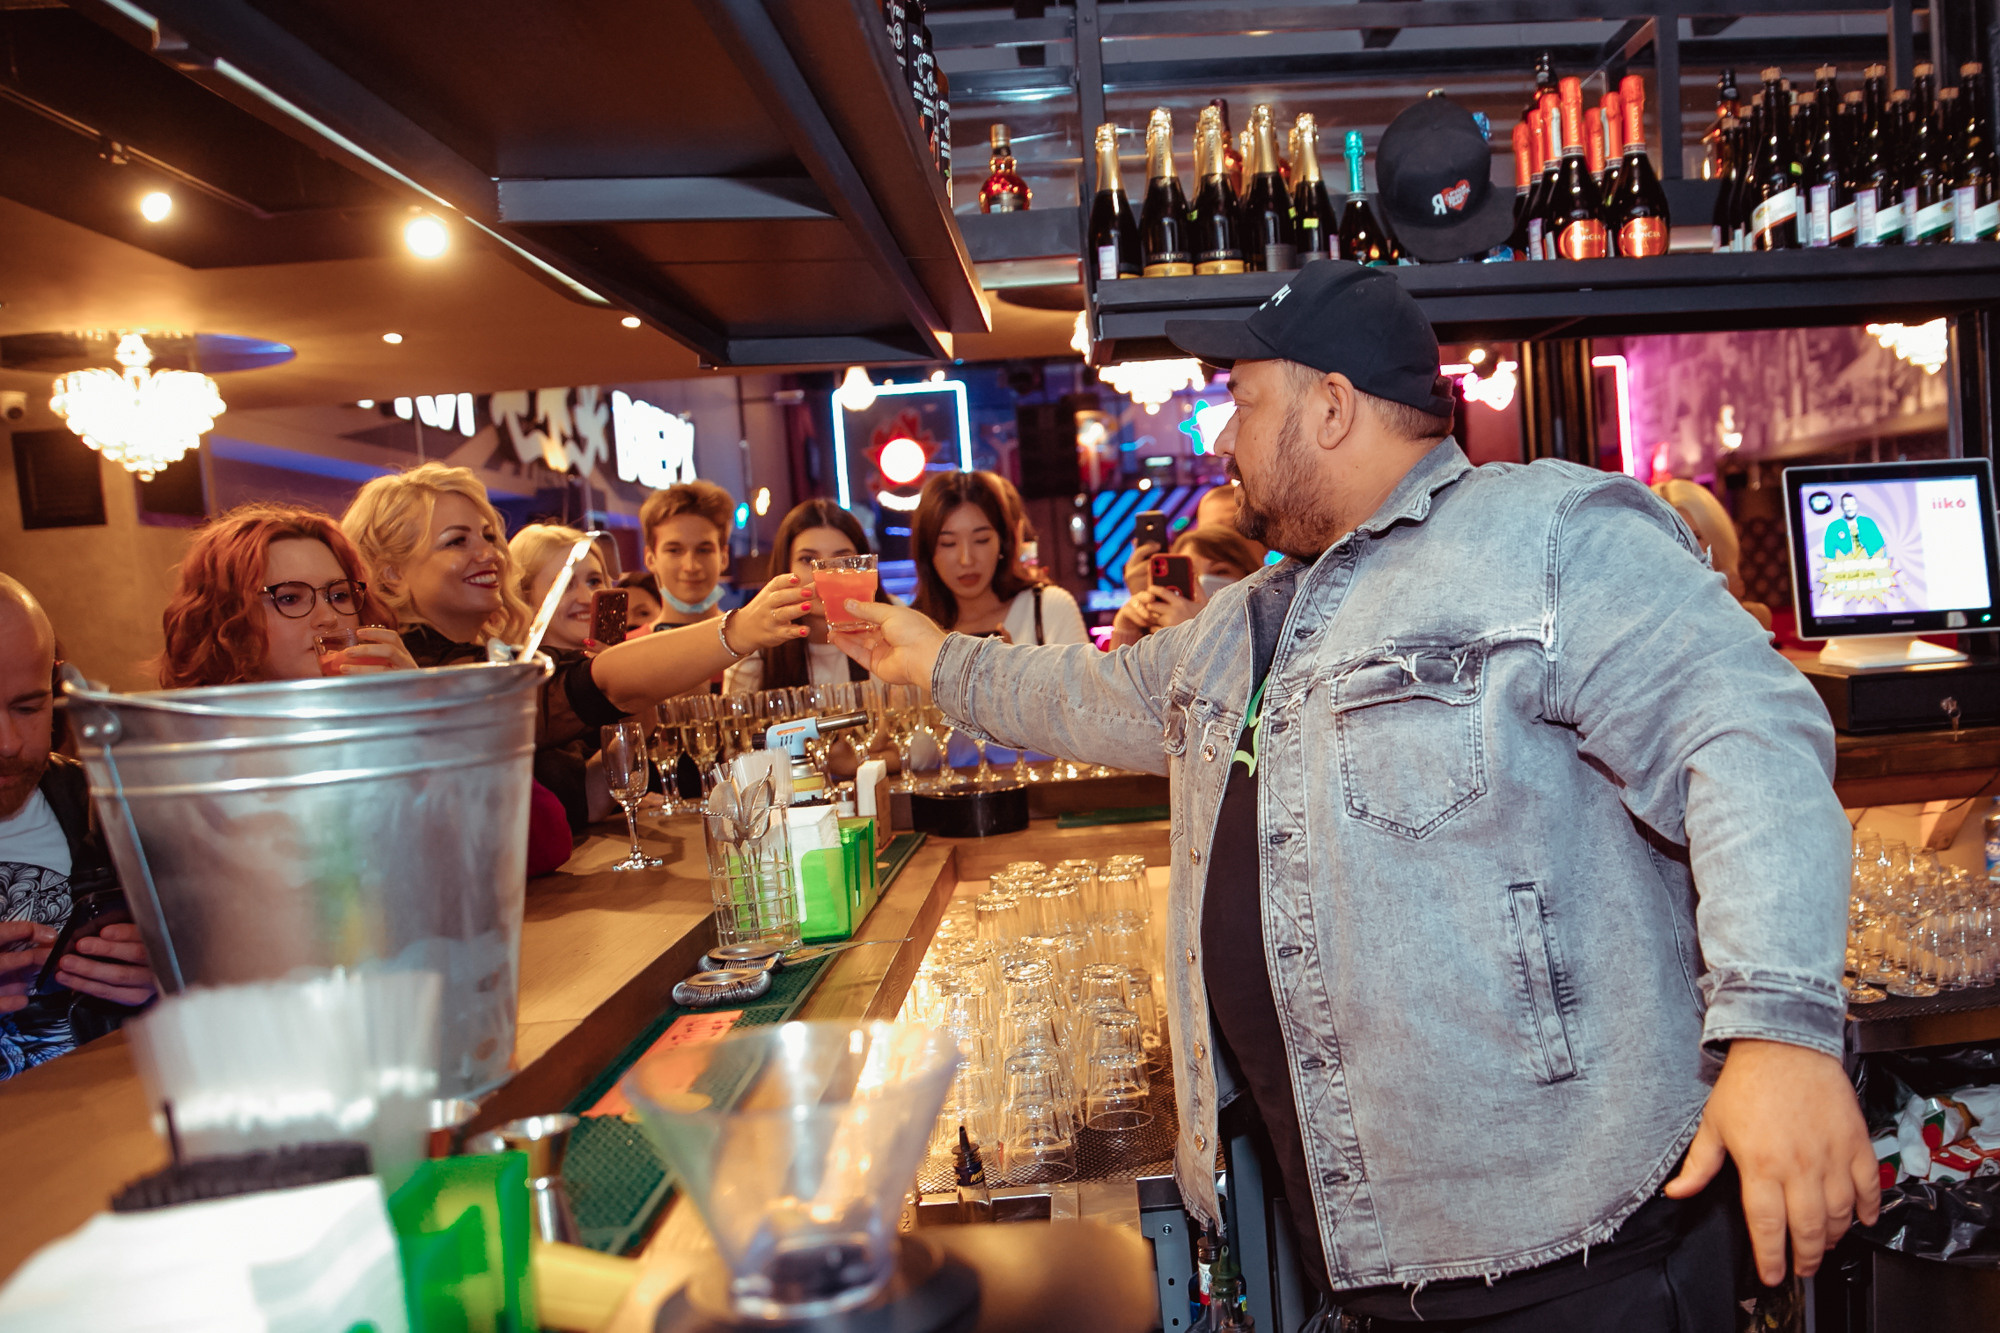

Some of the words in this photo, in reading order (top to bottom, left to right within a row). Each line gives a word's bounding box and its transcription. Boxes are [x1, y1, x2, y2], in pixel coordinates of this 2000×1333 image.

[1570, 107, 1578, 142] GANCIA
[1632, 106, 1640, 141] GANCIA
[1432, 193, 1447, 215] Я
[1932, 497, 1966, 509] iiko
